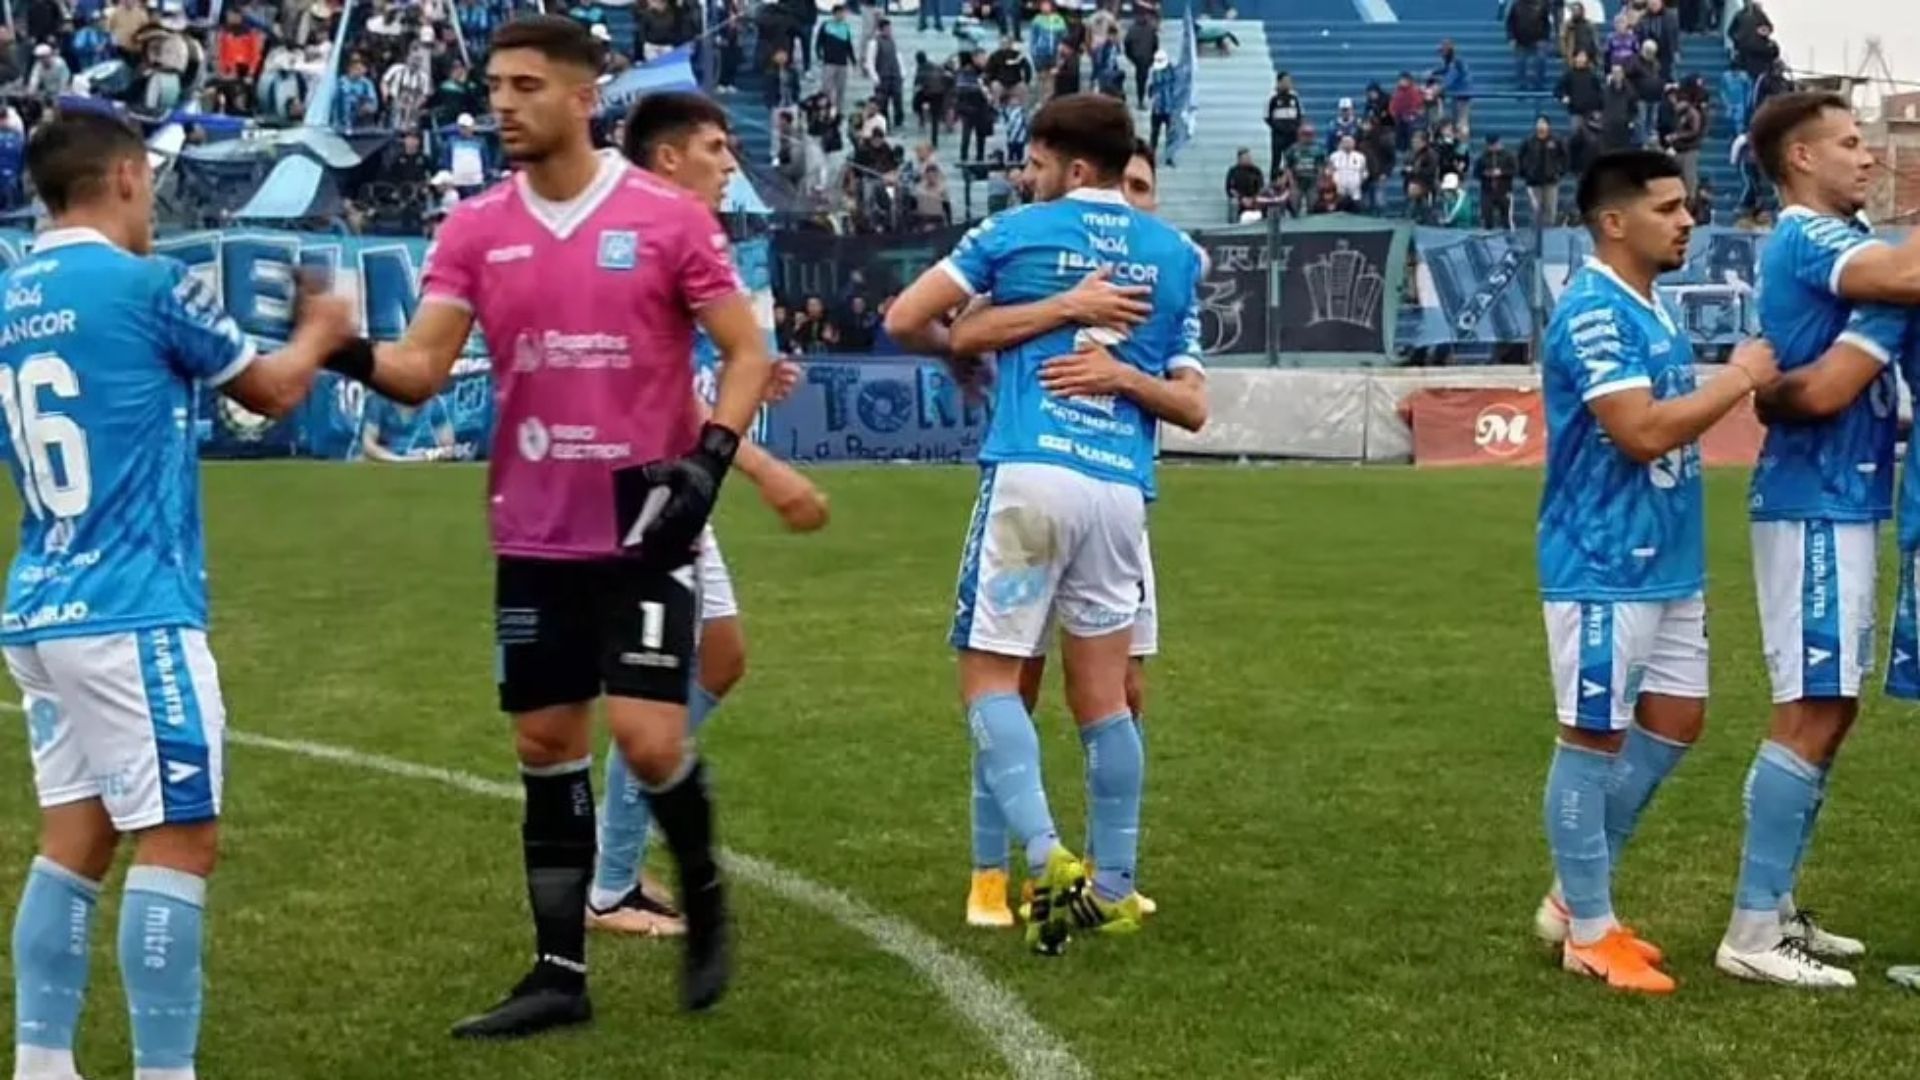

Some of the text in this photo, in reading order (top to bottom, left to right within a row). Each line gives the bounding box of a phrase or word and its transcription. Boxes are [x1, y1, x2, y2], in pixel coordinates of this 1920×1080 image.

[1083, 213, 1130, 227] mitre
[0, 352, 91, 520] 16
[1475, 414, 1529, 447] M
[640, 601, 665, 648] 1
[144, 906, 174, 968] mitre
